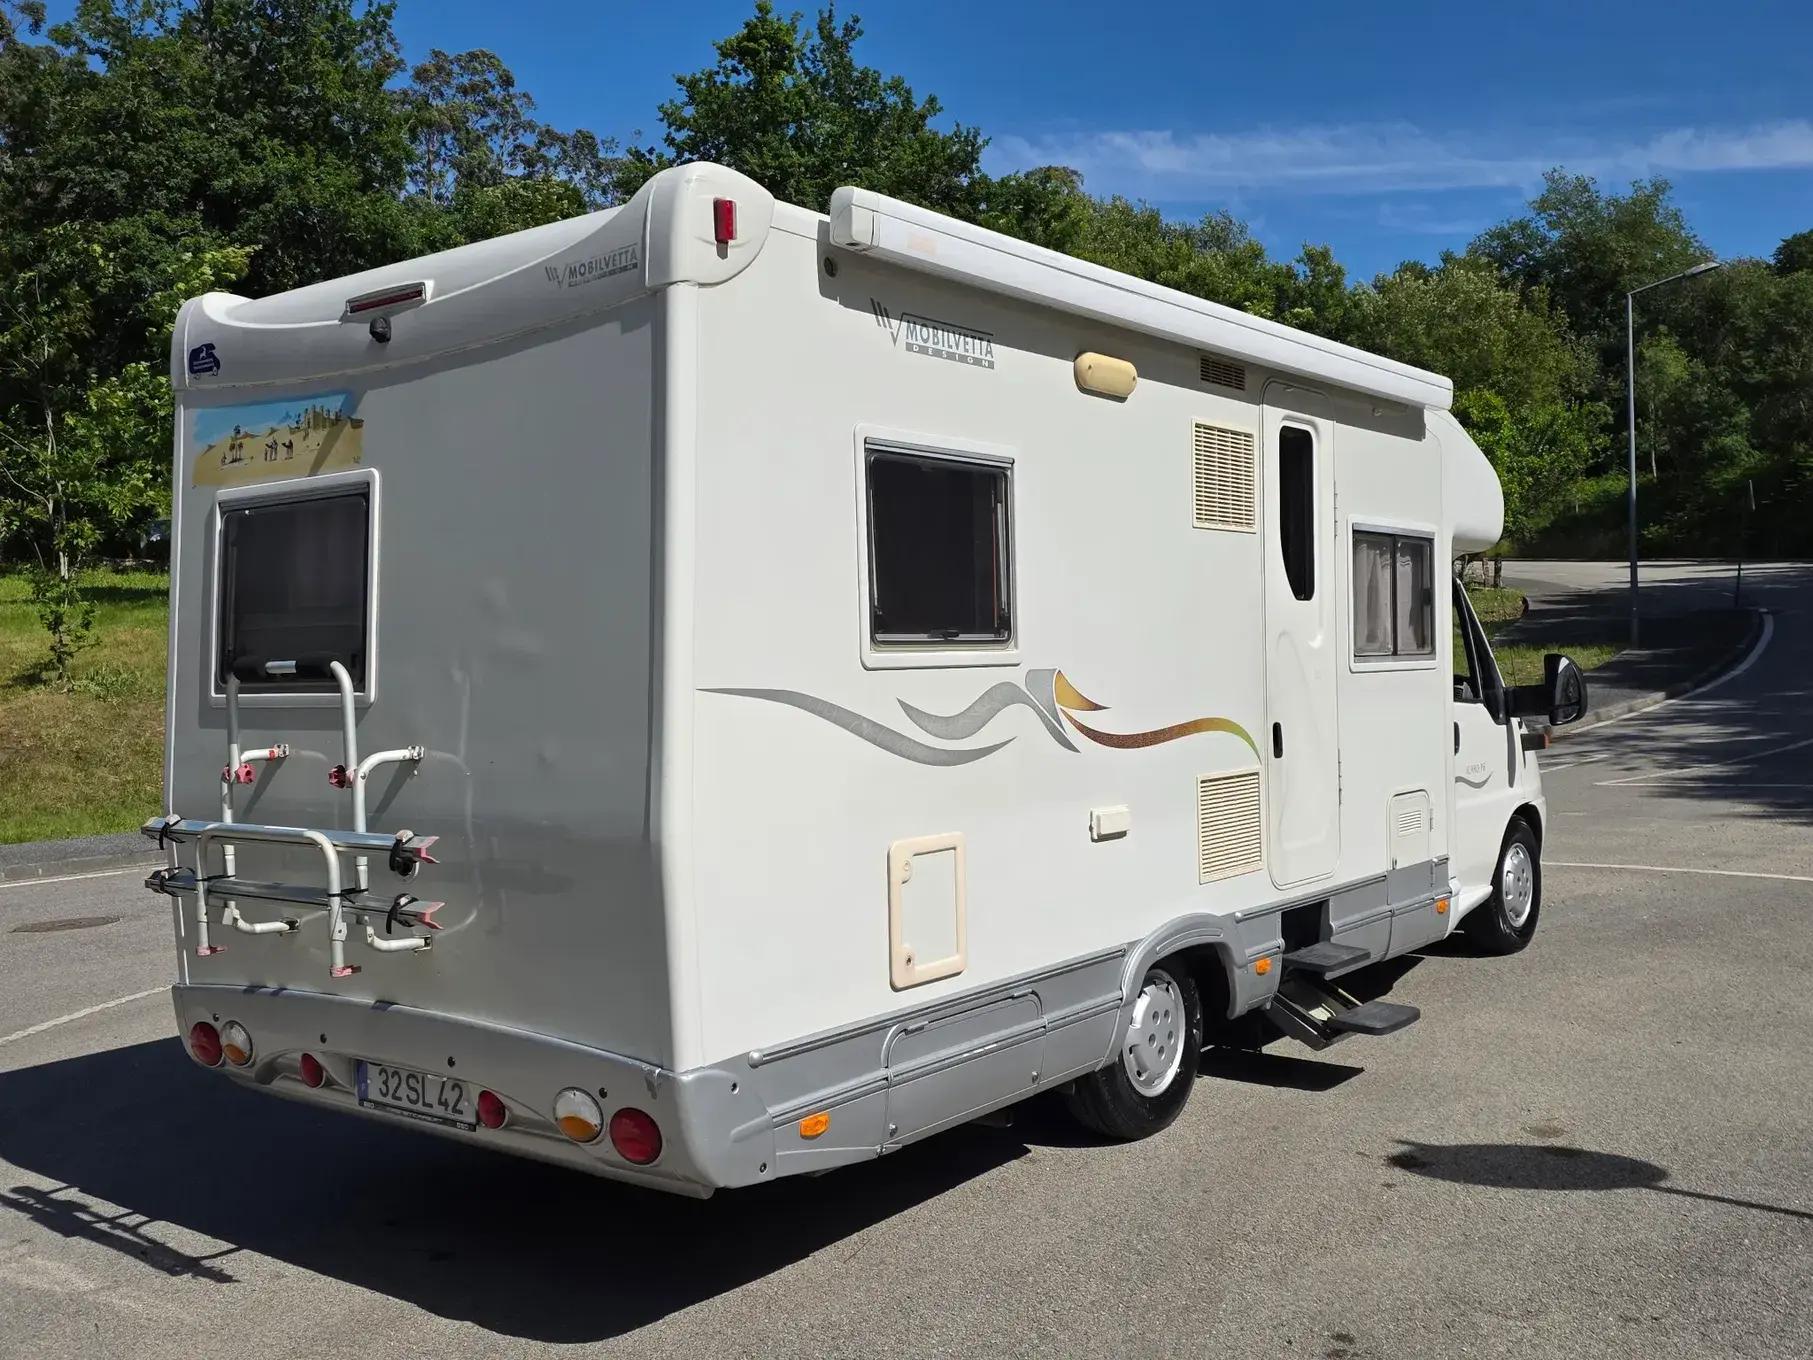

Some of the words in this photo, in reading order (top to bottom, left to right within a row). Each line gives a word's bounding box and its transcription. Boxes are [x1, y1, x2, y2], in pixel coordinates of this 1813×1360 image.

[568, 247, 638, 280] MOBILVETTA
[906, 320, 994, 358] MOBILVETTA
[912, 344, 989, 367] DESIGN
